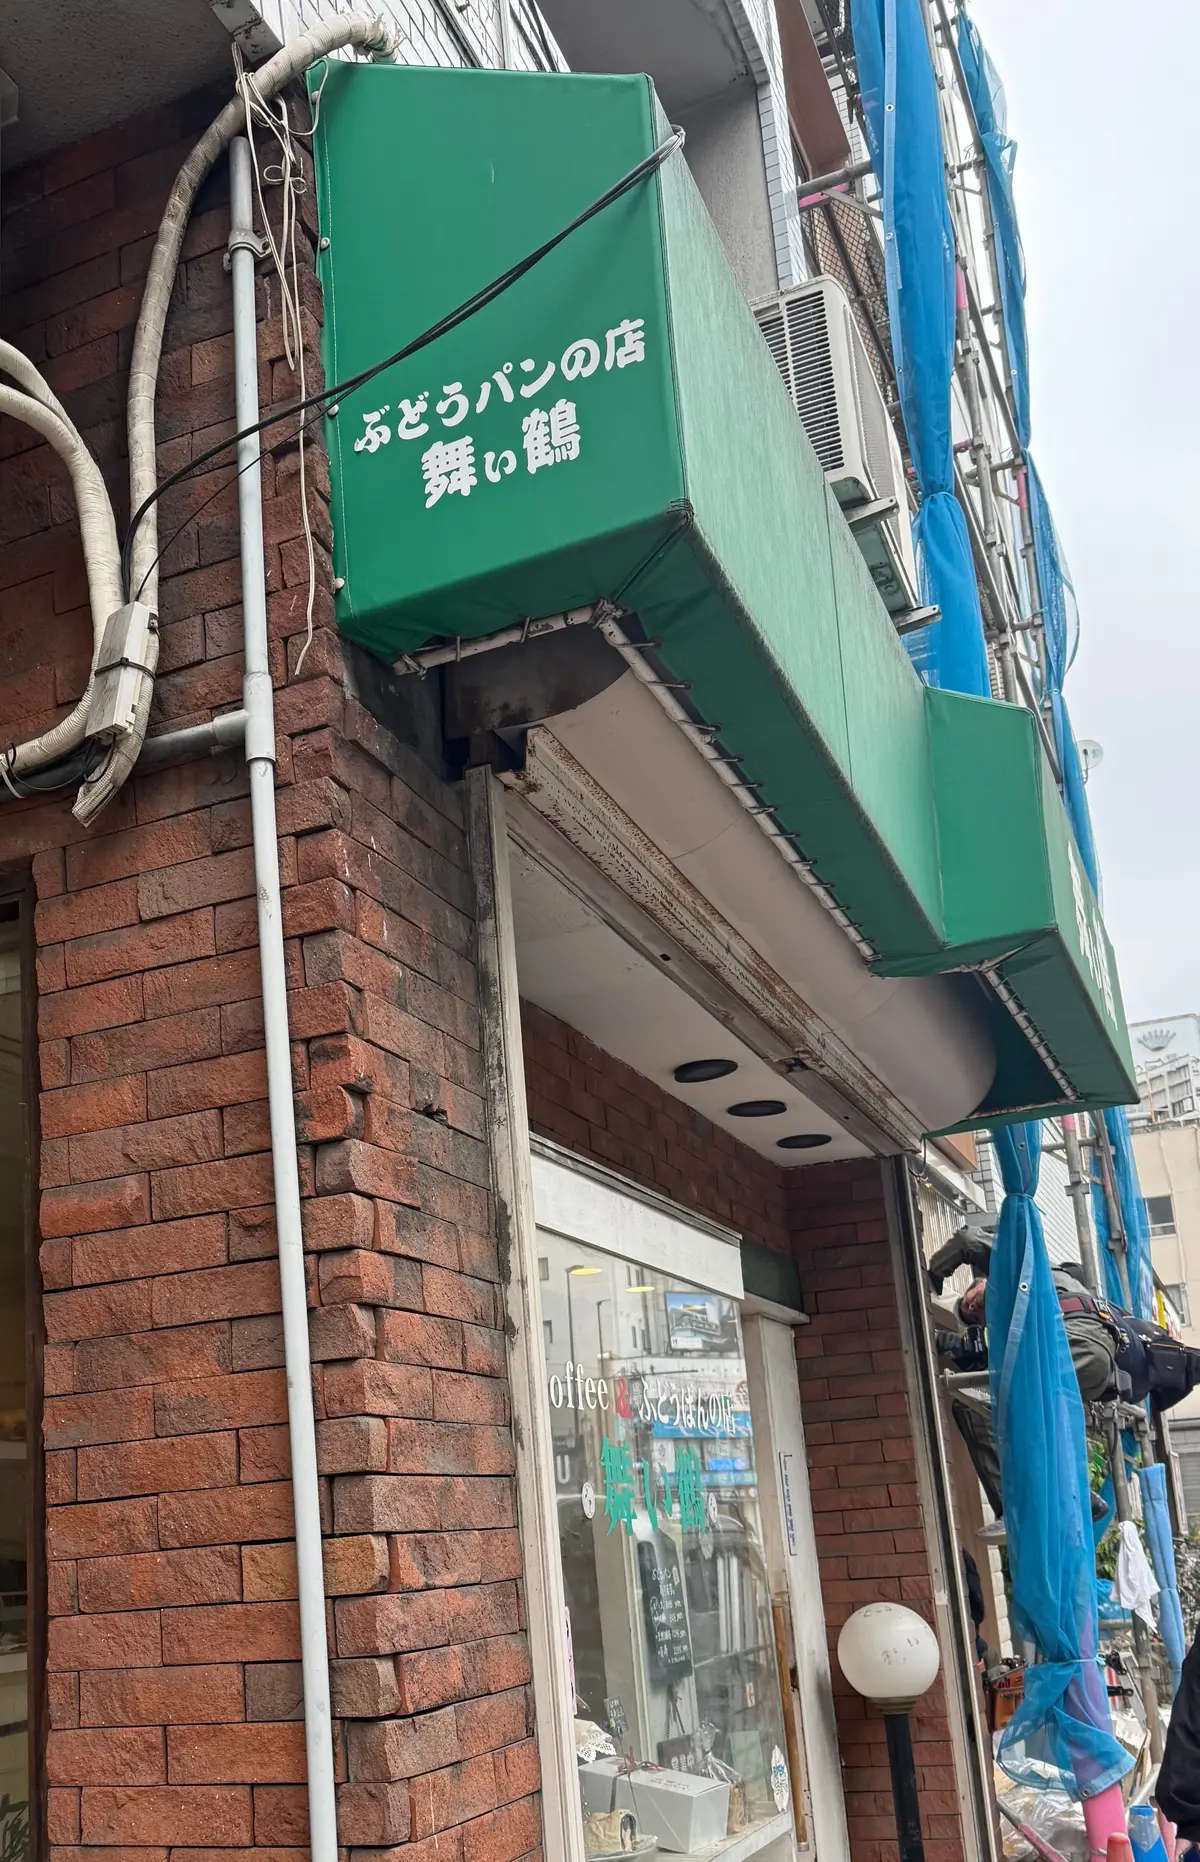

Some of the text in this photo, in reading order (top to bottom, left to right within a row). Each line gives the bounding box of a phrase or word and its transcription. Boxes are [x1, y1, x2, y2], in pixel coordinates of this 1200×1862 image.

[354, 318, 646, 454] ぶどうパンの店
[420, 398, 581, 509] 舞い鶴
[616, 1376, 633, 1419] &
[601, 1436, 705, 1537] 舞い鶴
